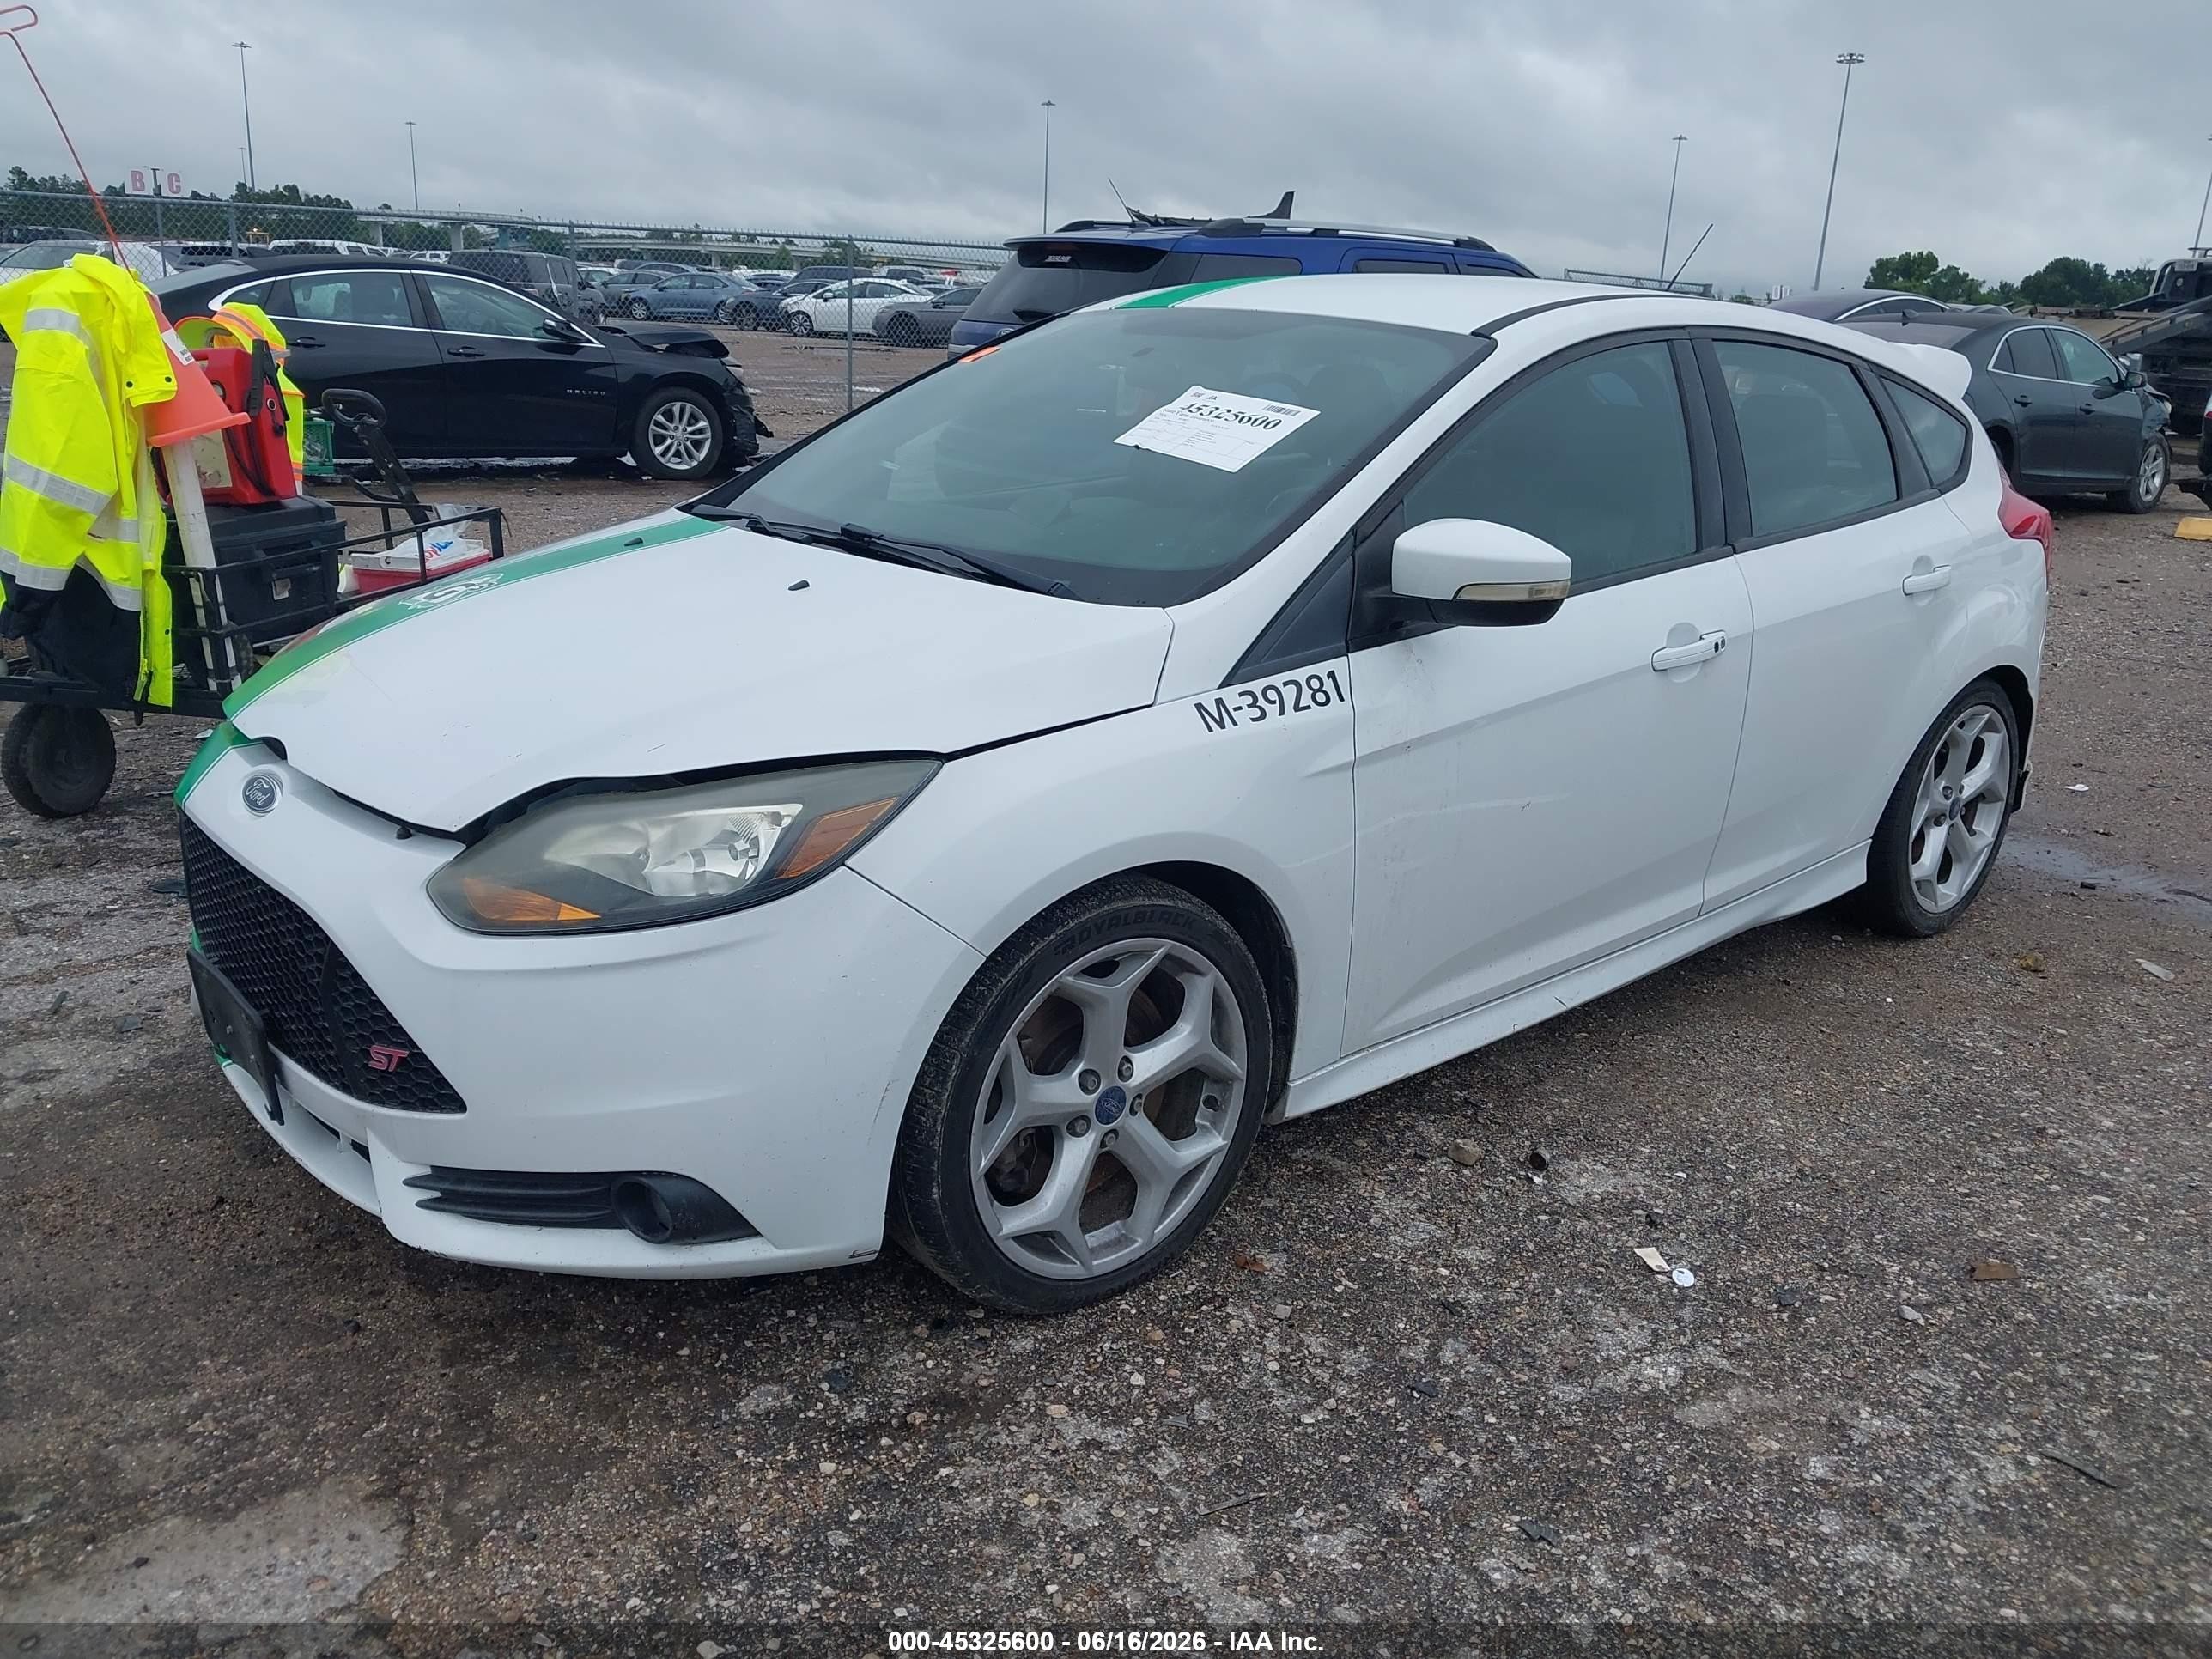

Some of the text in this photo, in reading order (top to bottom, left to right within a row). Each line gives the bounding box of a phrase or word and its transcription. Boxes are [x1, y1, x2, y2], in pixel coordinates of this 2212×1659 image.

[131, 170, 181, 194] B C
[1194, 670, 1346, 733] M-39281
[368, 1044, 410, 1073] ST
